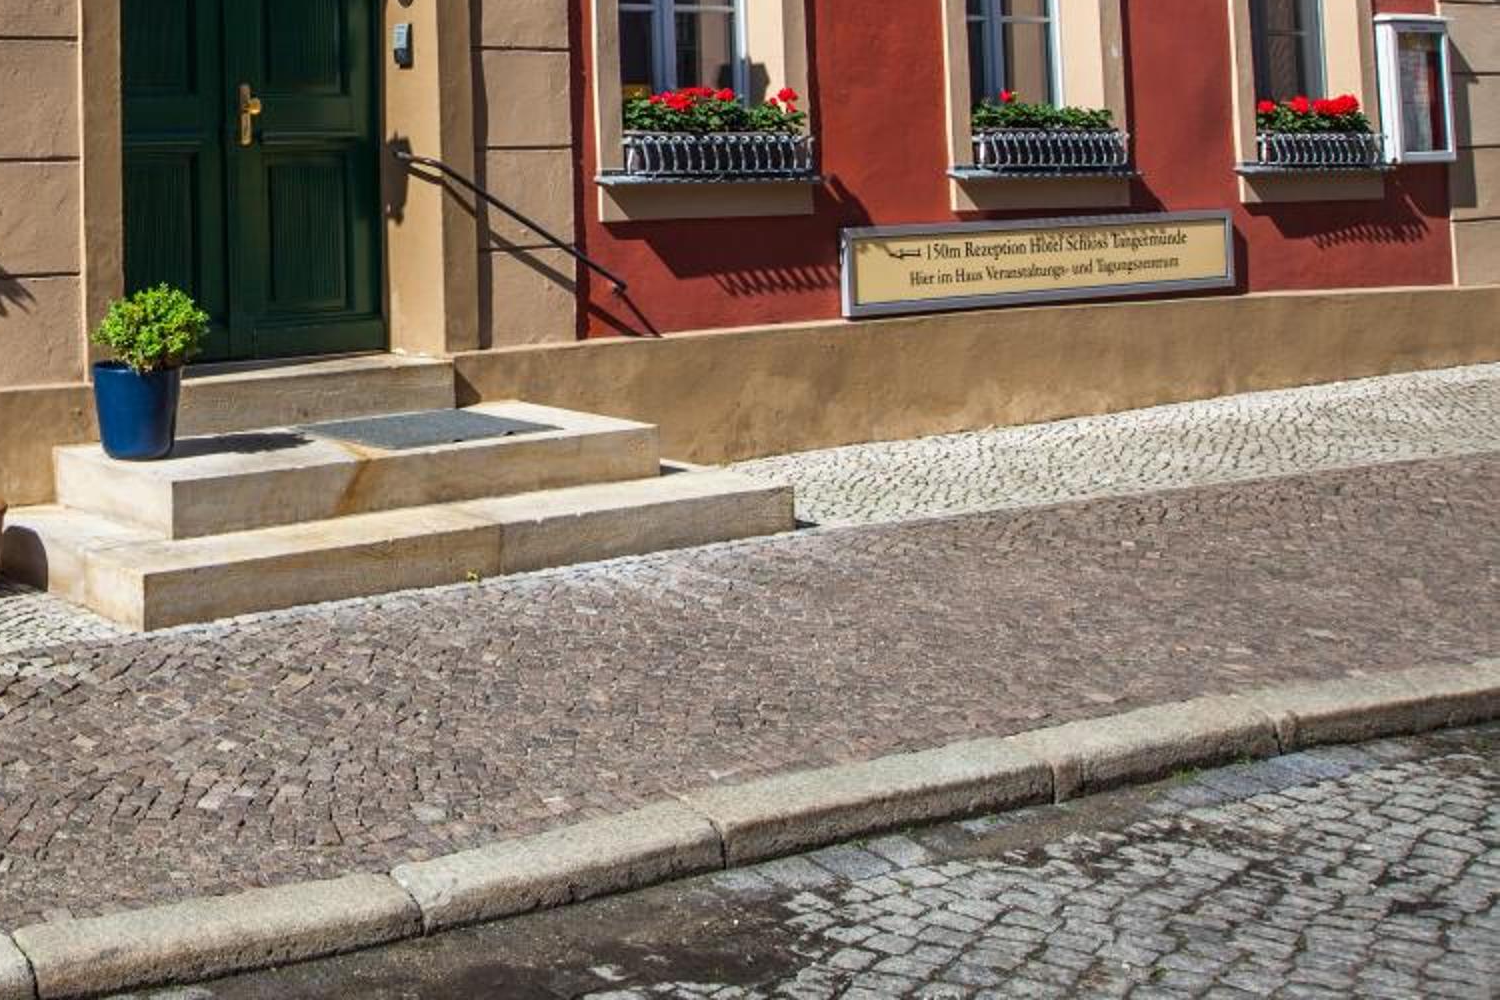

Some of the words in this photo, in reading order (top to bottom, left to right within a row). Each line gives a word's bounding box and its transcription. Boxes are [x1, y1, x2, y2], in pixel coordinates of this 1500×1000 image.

[927, 242, 961, 260] 150m
[964, 240, 1027, 261] Rezeption
[1030, 234, 1064, 254] Hotel
[1067, 232, 1109, 252] Schloss
[910, 269, 934, 286] Hier
[937, 269, 953, 284] im
[955, 267, 983, 283] Haus
[1071, 258, 1093, 274] und
